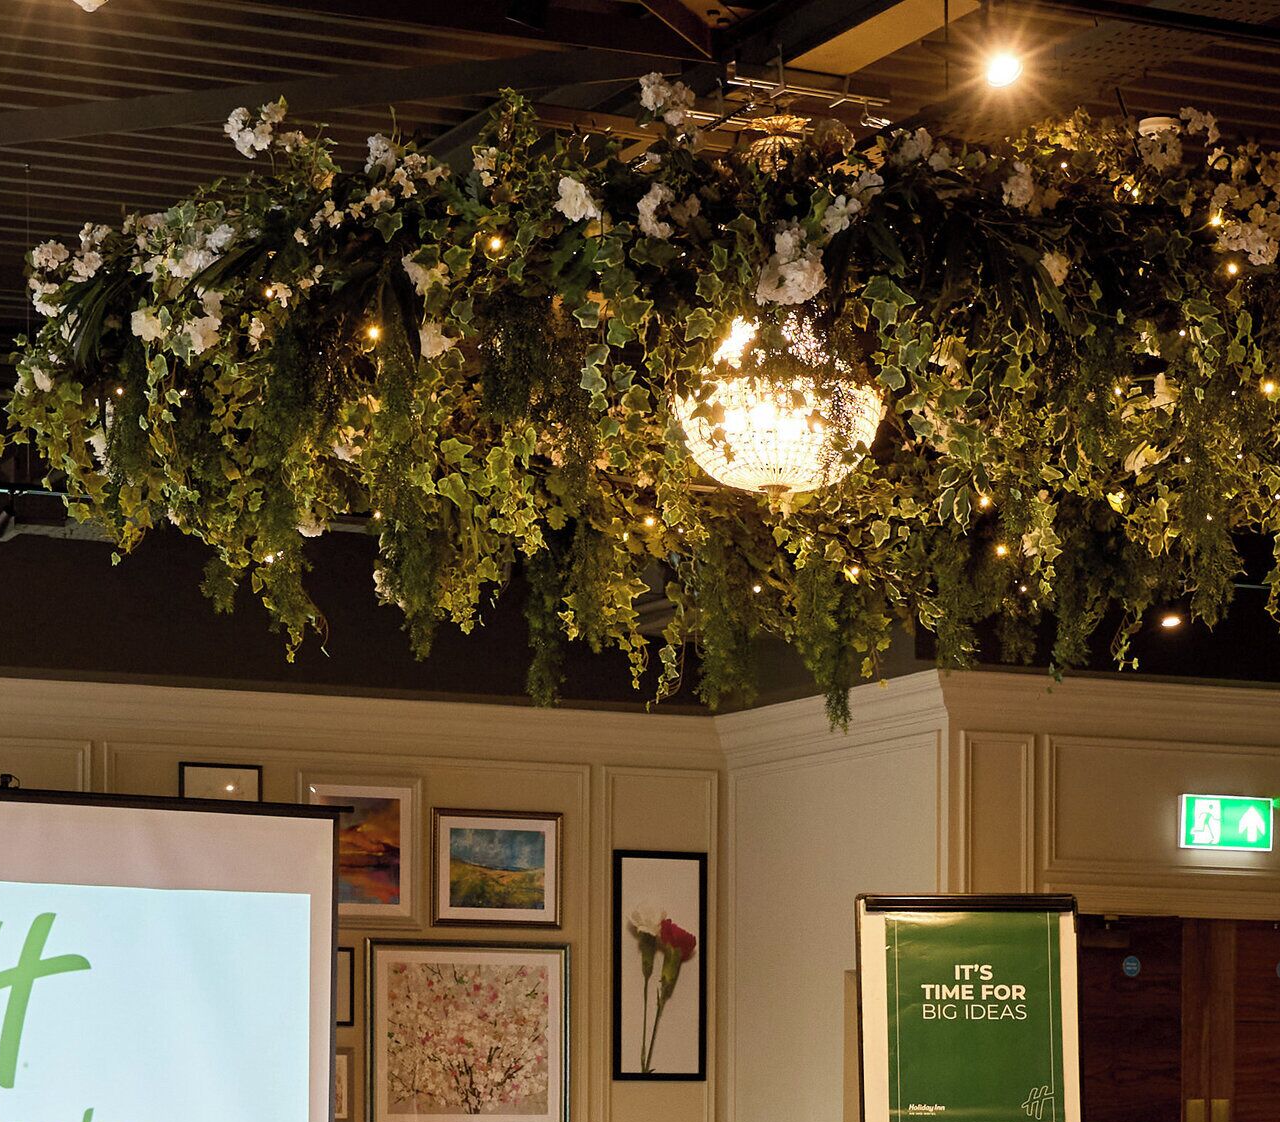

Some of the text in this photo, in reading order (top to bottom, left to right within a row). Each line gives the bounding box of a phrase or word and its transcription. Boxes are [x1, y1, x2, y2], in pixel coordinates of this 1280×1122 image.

[954, 964, 994, 981] IT'S
[920, 984, 1027, 1001] TIME FOR
[922, 1003, 1028, 1021] BIG IDEAS
[908, 1103, 946, 1112] Holiday Inn
